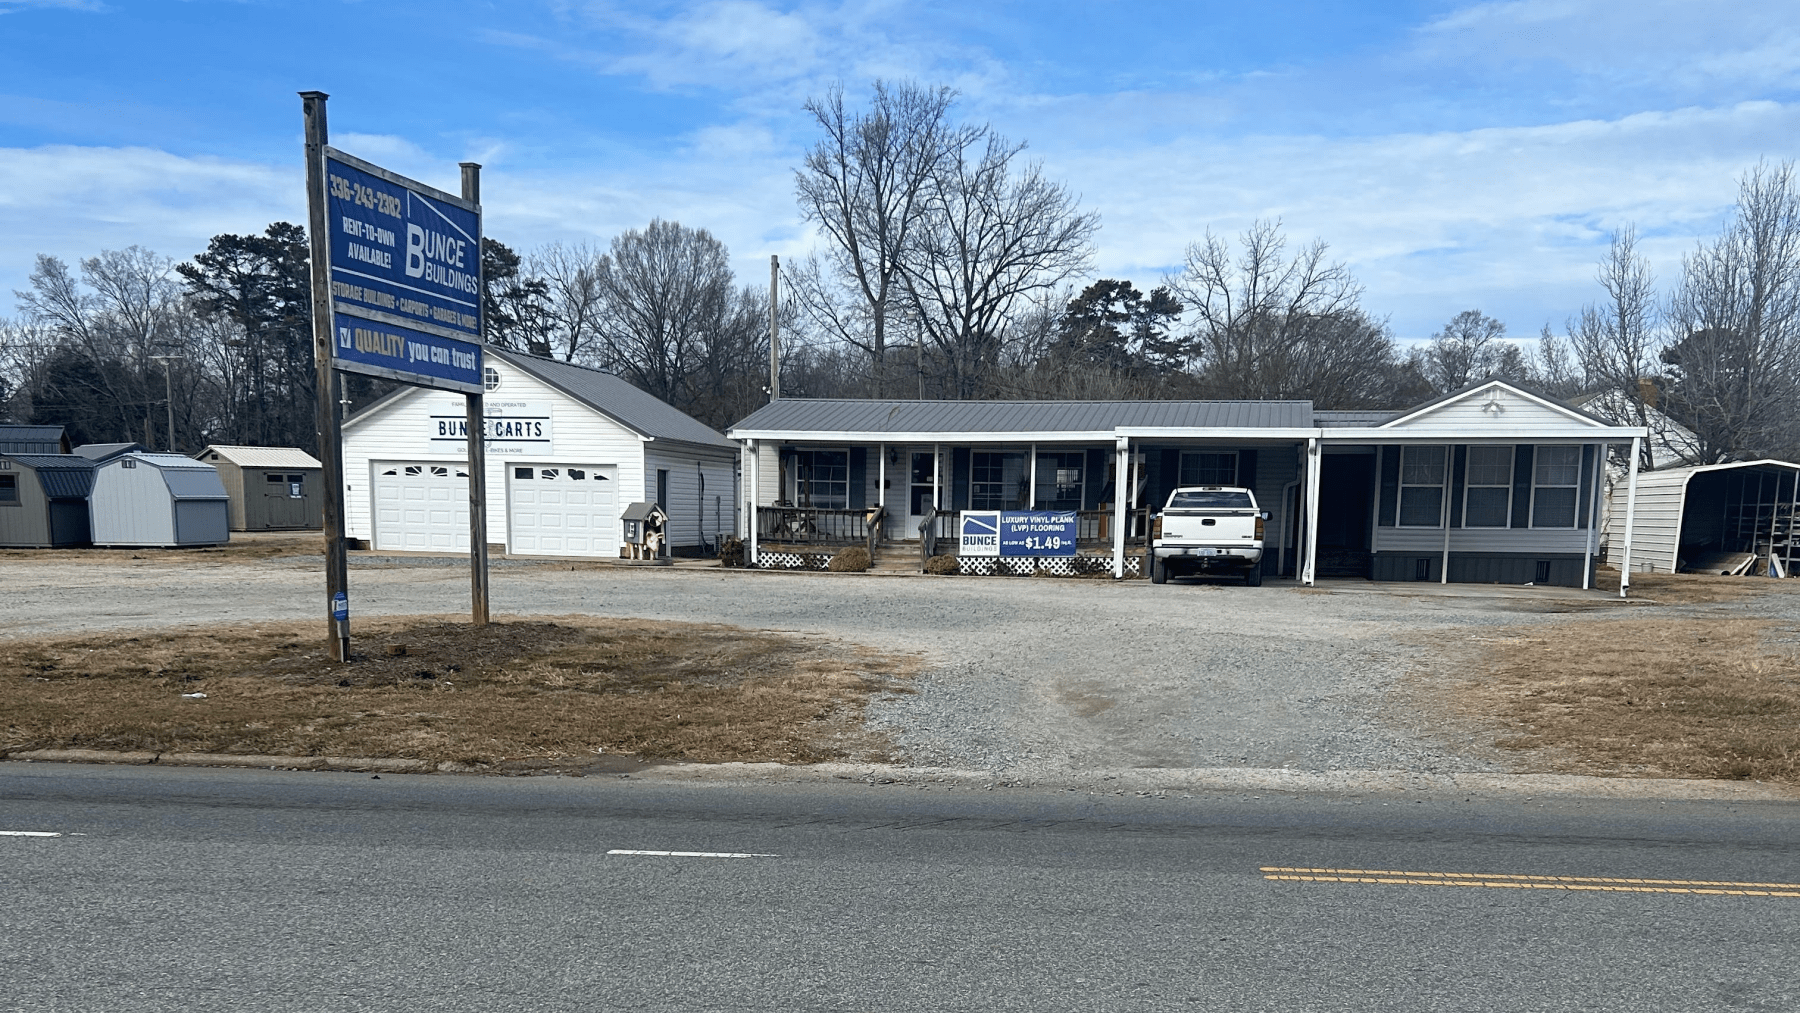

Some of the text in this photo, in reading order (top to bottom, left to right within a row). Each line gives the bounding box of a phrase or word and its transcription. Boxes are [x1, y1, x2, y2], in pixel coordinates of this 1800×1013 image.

[330, 174, 401, 219] 336-243-2382
[342, 216, 395, 247] RENT-TO-OWN
[348, 242, 391, 269] AVAILABLE!
[405, 222, 466, 278] BUNCE
[425, 263, 478, 295] BUILDINGS
[332, 281, 363, 301] STORAGE
[363, 288, 395, 309] BUILDINGS
[400, 297, 429, 318] CARPORTS
[433, 306, 457, 324] GARAGES
[355, 328, 476, 371] QUALITY you can trust
[438, 421, 542, 437] BUNE CARTS
[962, 536, 996, 546] BUNCE
[1011, 524, 1028, 532] (LVP)
[1025, 536, 1060, 550] $1.49
